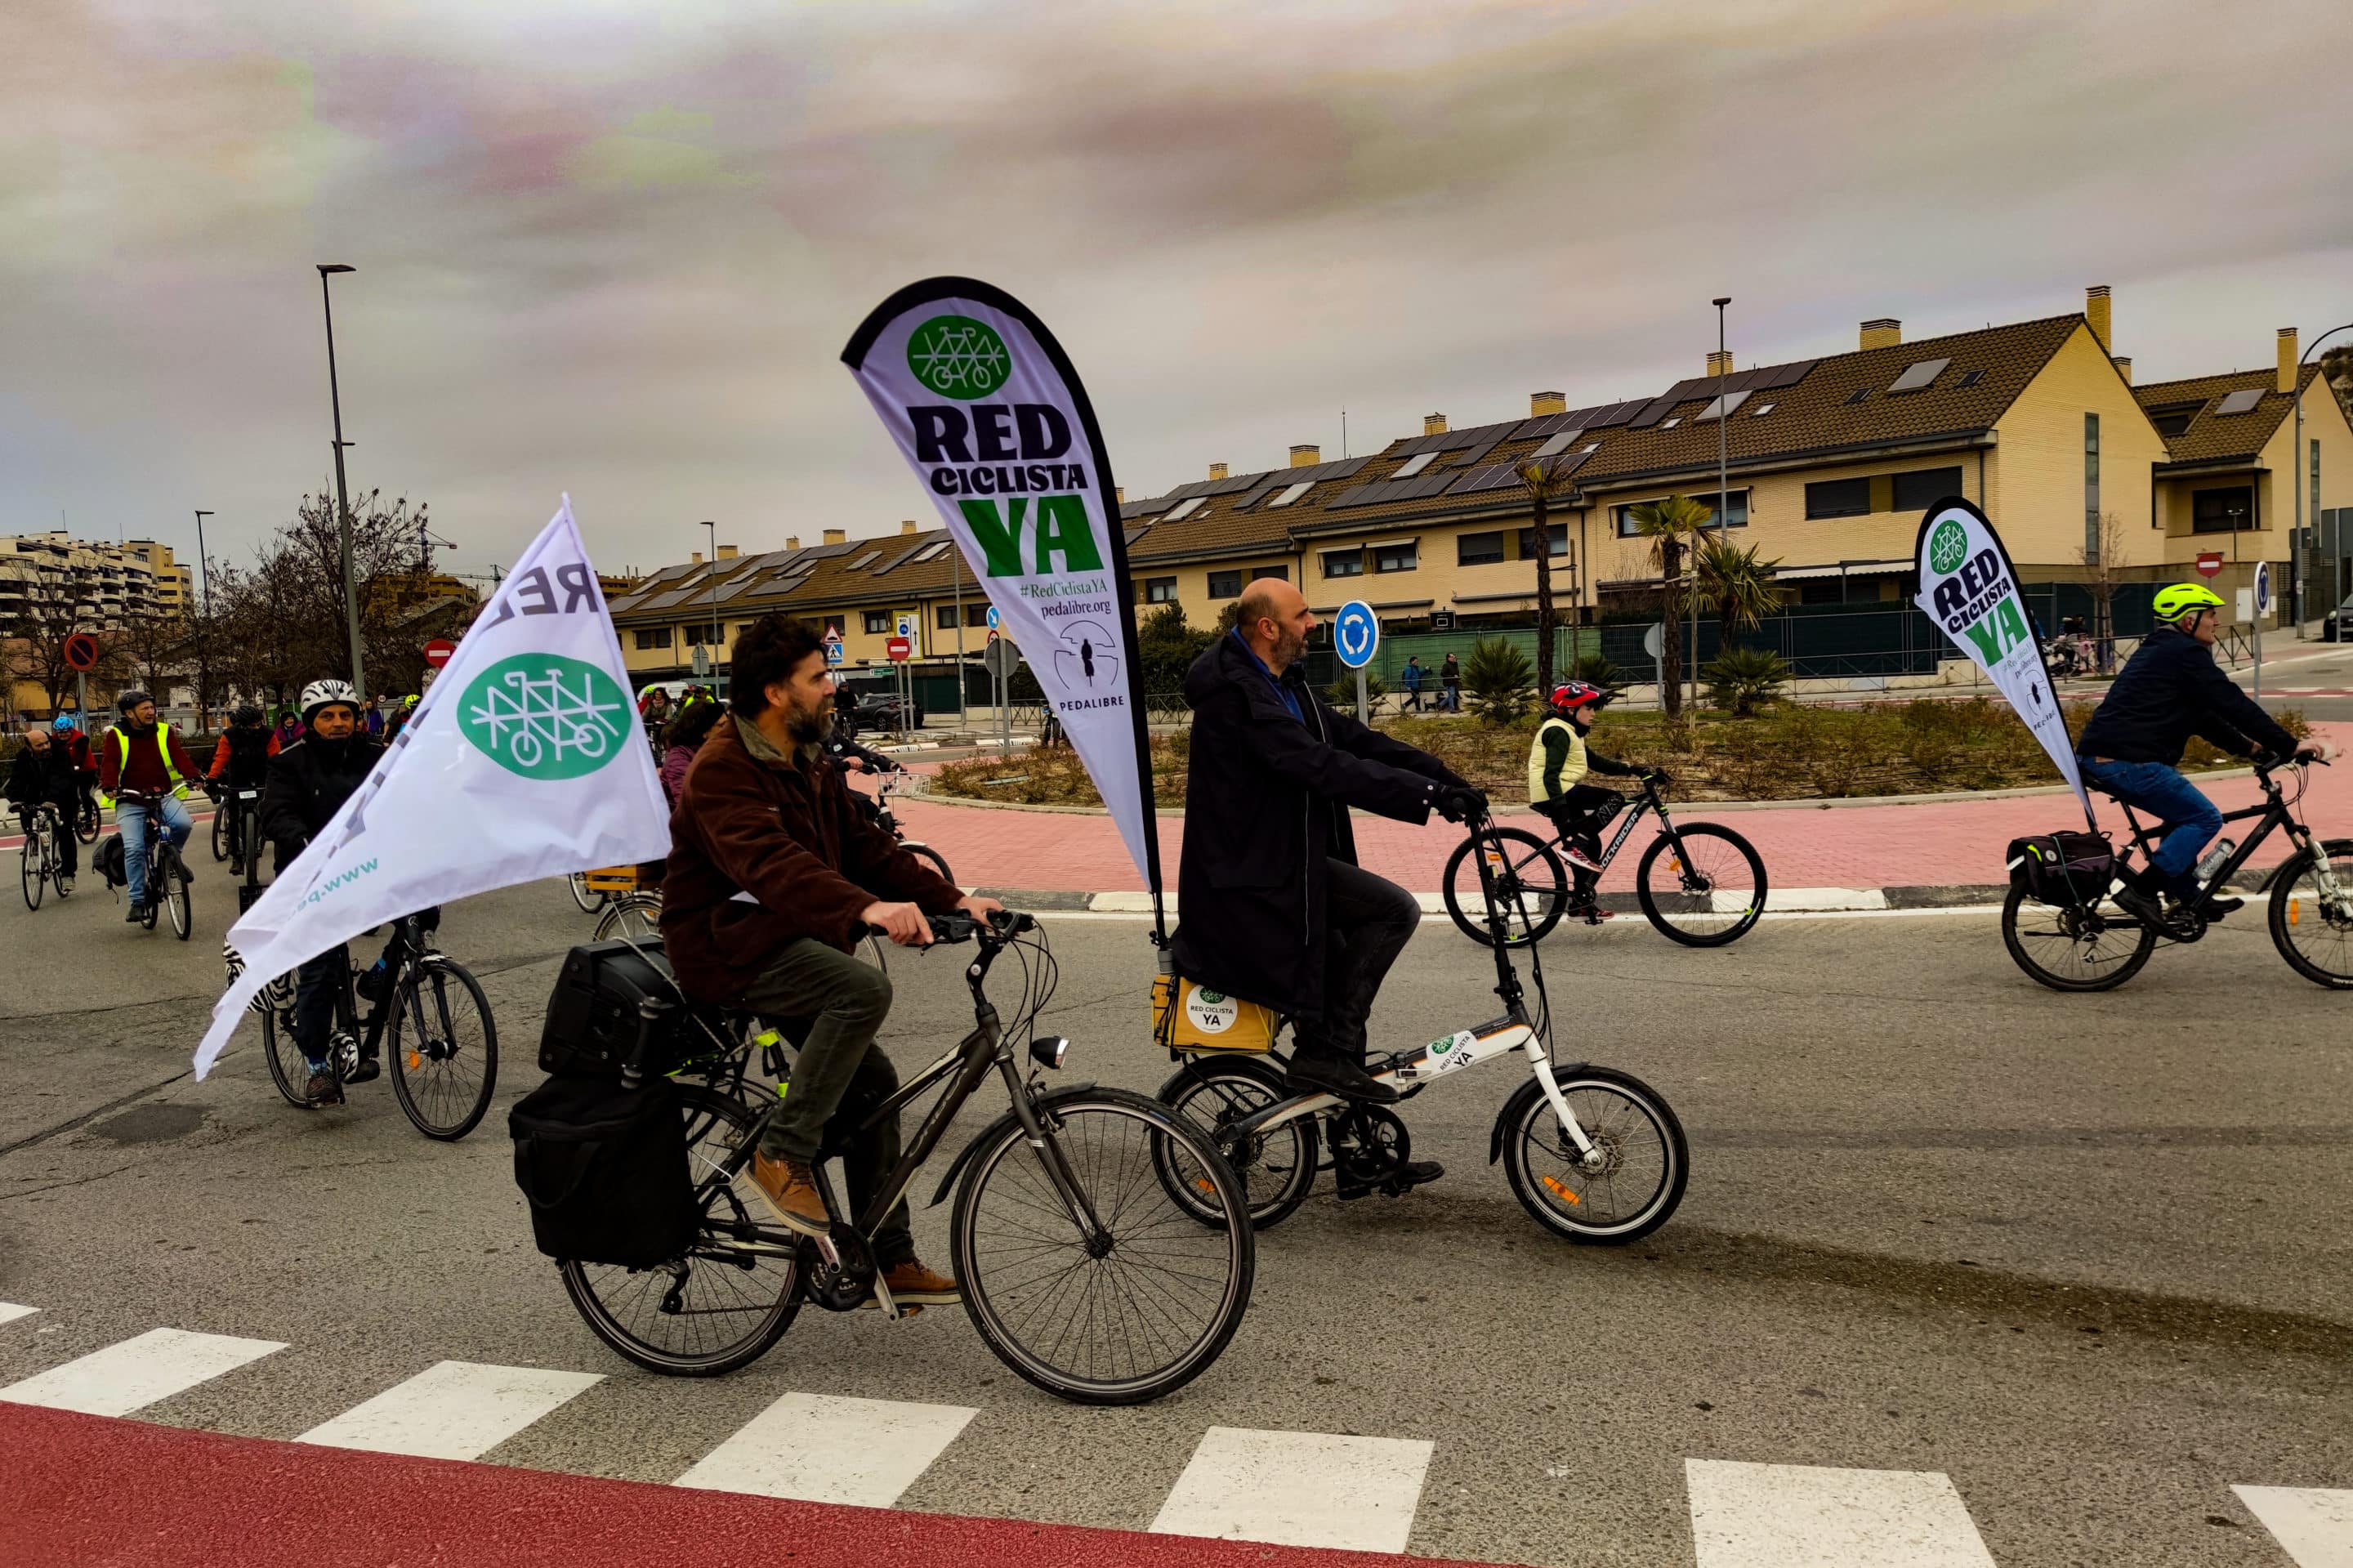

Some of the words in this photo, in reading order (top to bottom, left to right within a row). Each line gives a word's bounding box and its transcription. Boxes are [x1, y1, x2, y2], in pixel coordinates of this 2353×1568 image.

[906, 404, 1072, 462] RED
[931, 464, 1088, 495] CICLISTA
[958, 494, 1105, 577] YA
[1020, 579, 1107, 598] #RedCiclistaYA
[1933, 548, 2000, 621] RED
[1042, 600, 1111, 619] pedalibre.org
[1948, 577, 2011, 634] CICLISTA
[1964, 596, 2029, 668] YA
[1060, 695, 1124, 711] PEDALIBRE
[1203, 1013, 1221, 1026] YA
[1440, 1058, 1452, 1070] RED
[1450, 1035, 1471, 1058] CICLISTA
[1453, 1052, 1473, 1066] YA
